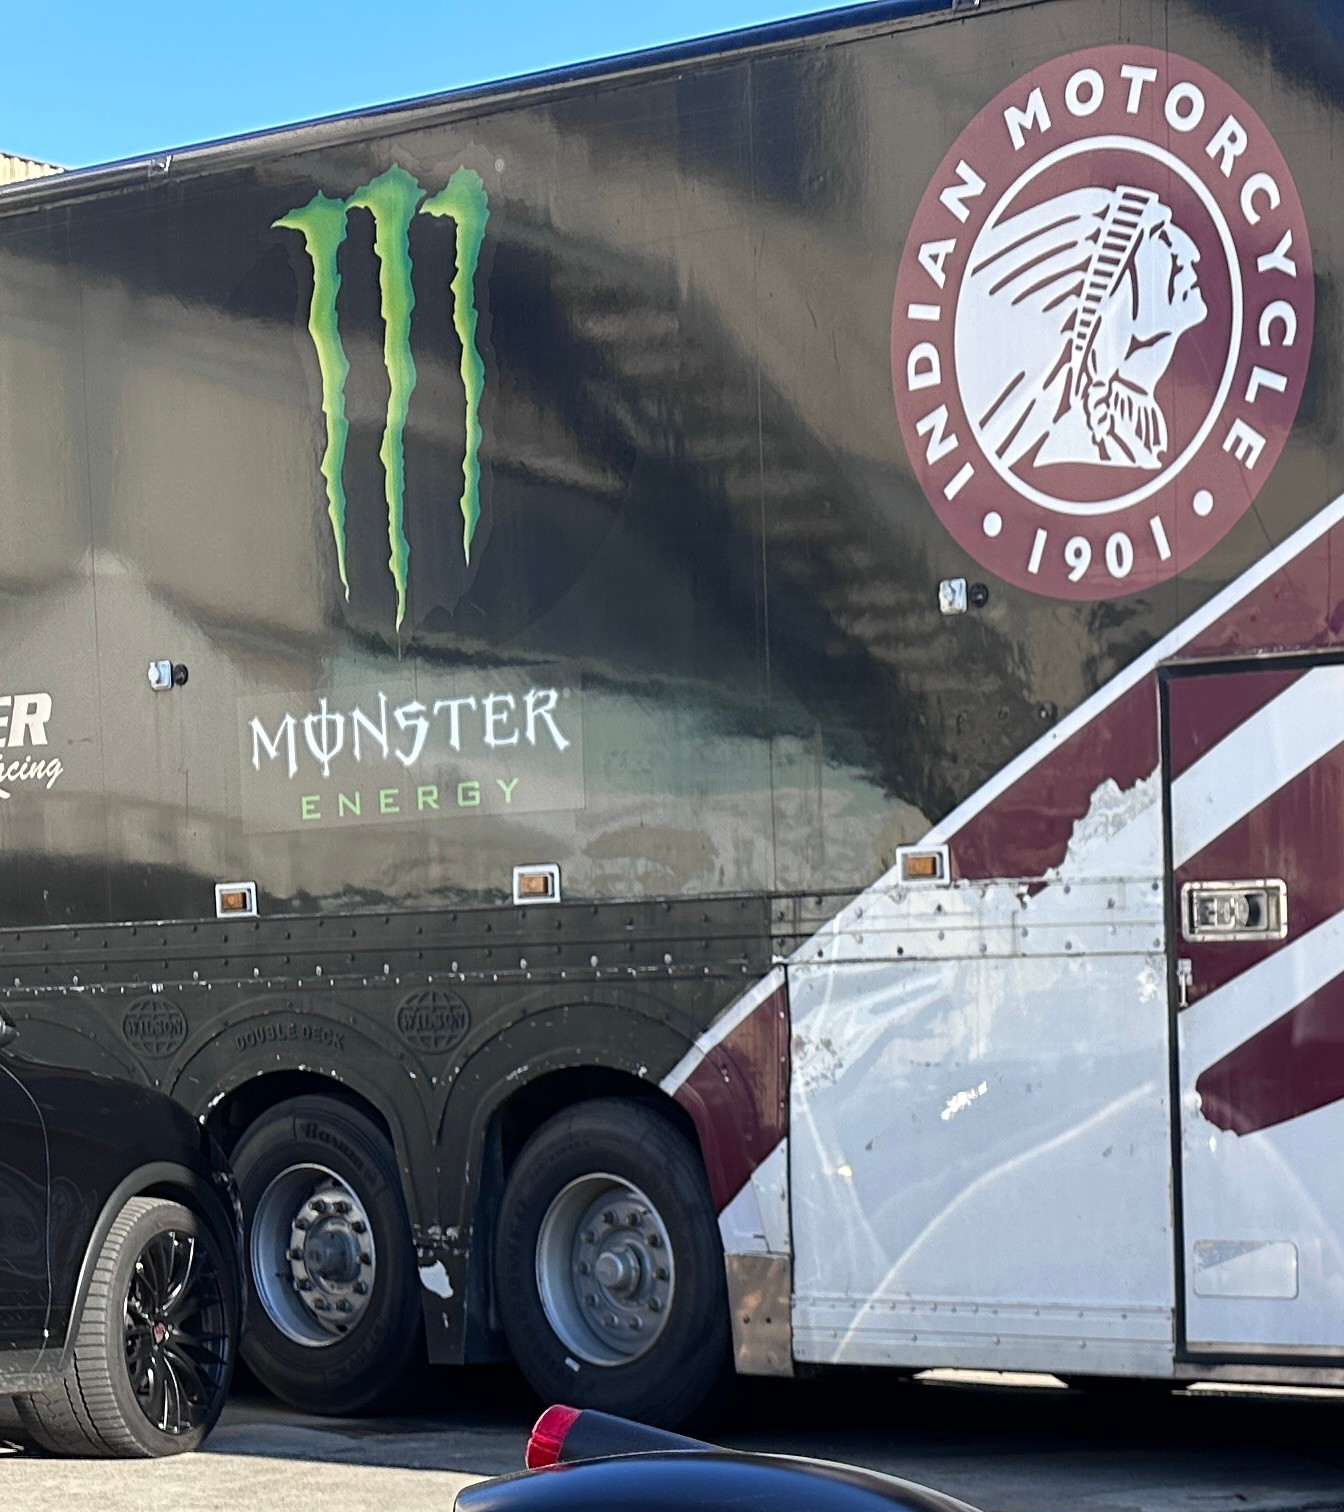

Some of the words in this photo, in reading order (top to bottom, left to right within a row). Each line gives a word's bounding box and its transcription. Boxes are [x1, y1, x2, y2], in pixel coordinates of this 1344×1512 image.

[907, 159, 988, 501] INDIAN
[1003, 64, 1299, 471] MOTORCYCLE
[1027, 515, 1171, 582] 1901
[249, 688, 570, 780] MONSTER
[301, 777, 519, 820] ENERGY
[123, 1015, 187, 1039] WILSON
[236, 1023, 298, 1051] DOUBLE
[302, 1023, 345, 1049] DECK
[401, 1008, 470, 1034] WILSON
